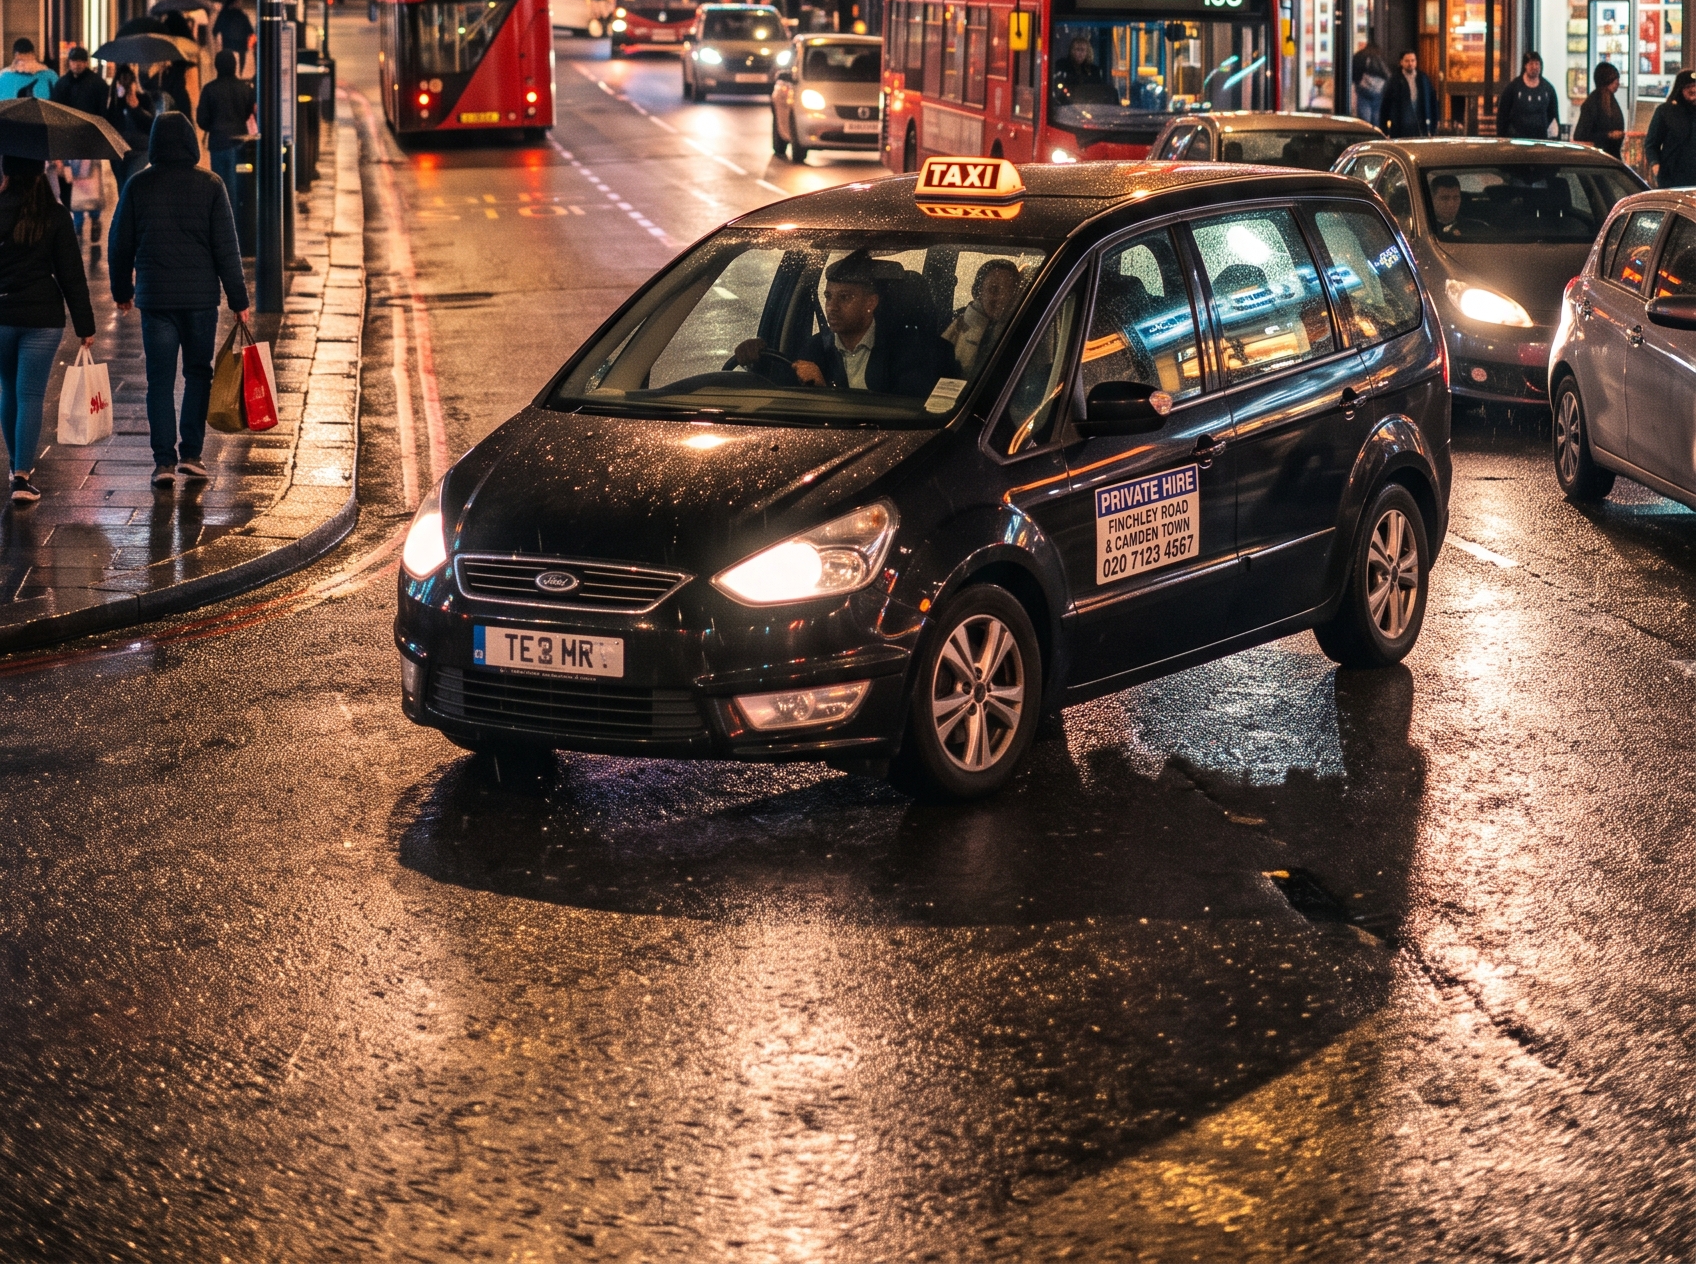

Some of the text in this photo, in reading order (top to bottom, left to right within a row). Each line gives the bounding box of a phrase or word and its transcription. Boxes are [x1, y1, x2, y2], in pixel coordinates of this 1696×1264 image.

[930, 164, 994, 187] TAXI
[1101, 470, 1194, 514] PRIVATE HIRE
[1105, 516, 1190, 554] & CAMDEN TOWN
[1108, 499, 1189, 535] FINCHLEY ROAD
[1103, 533, 1194, 578] 020 7123 4567
